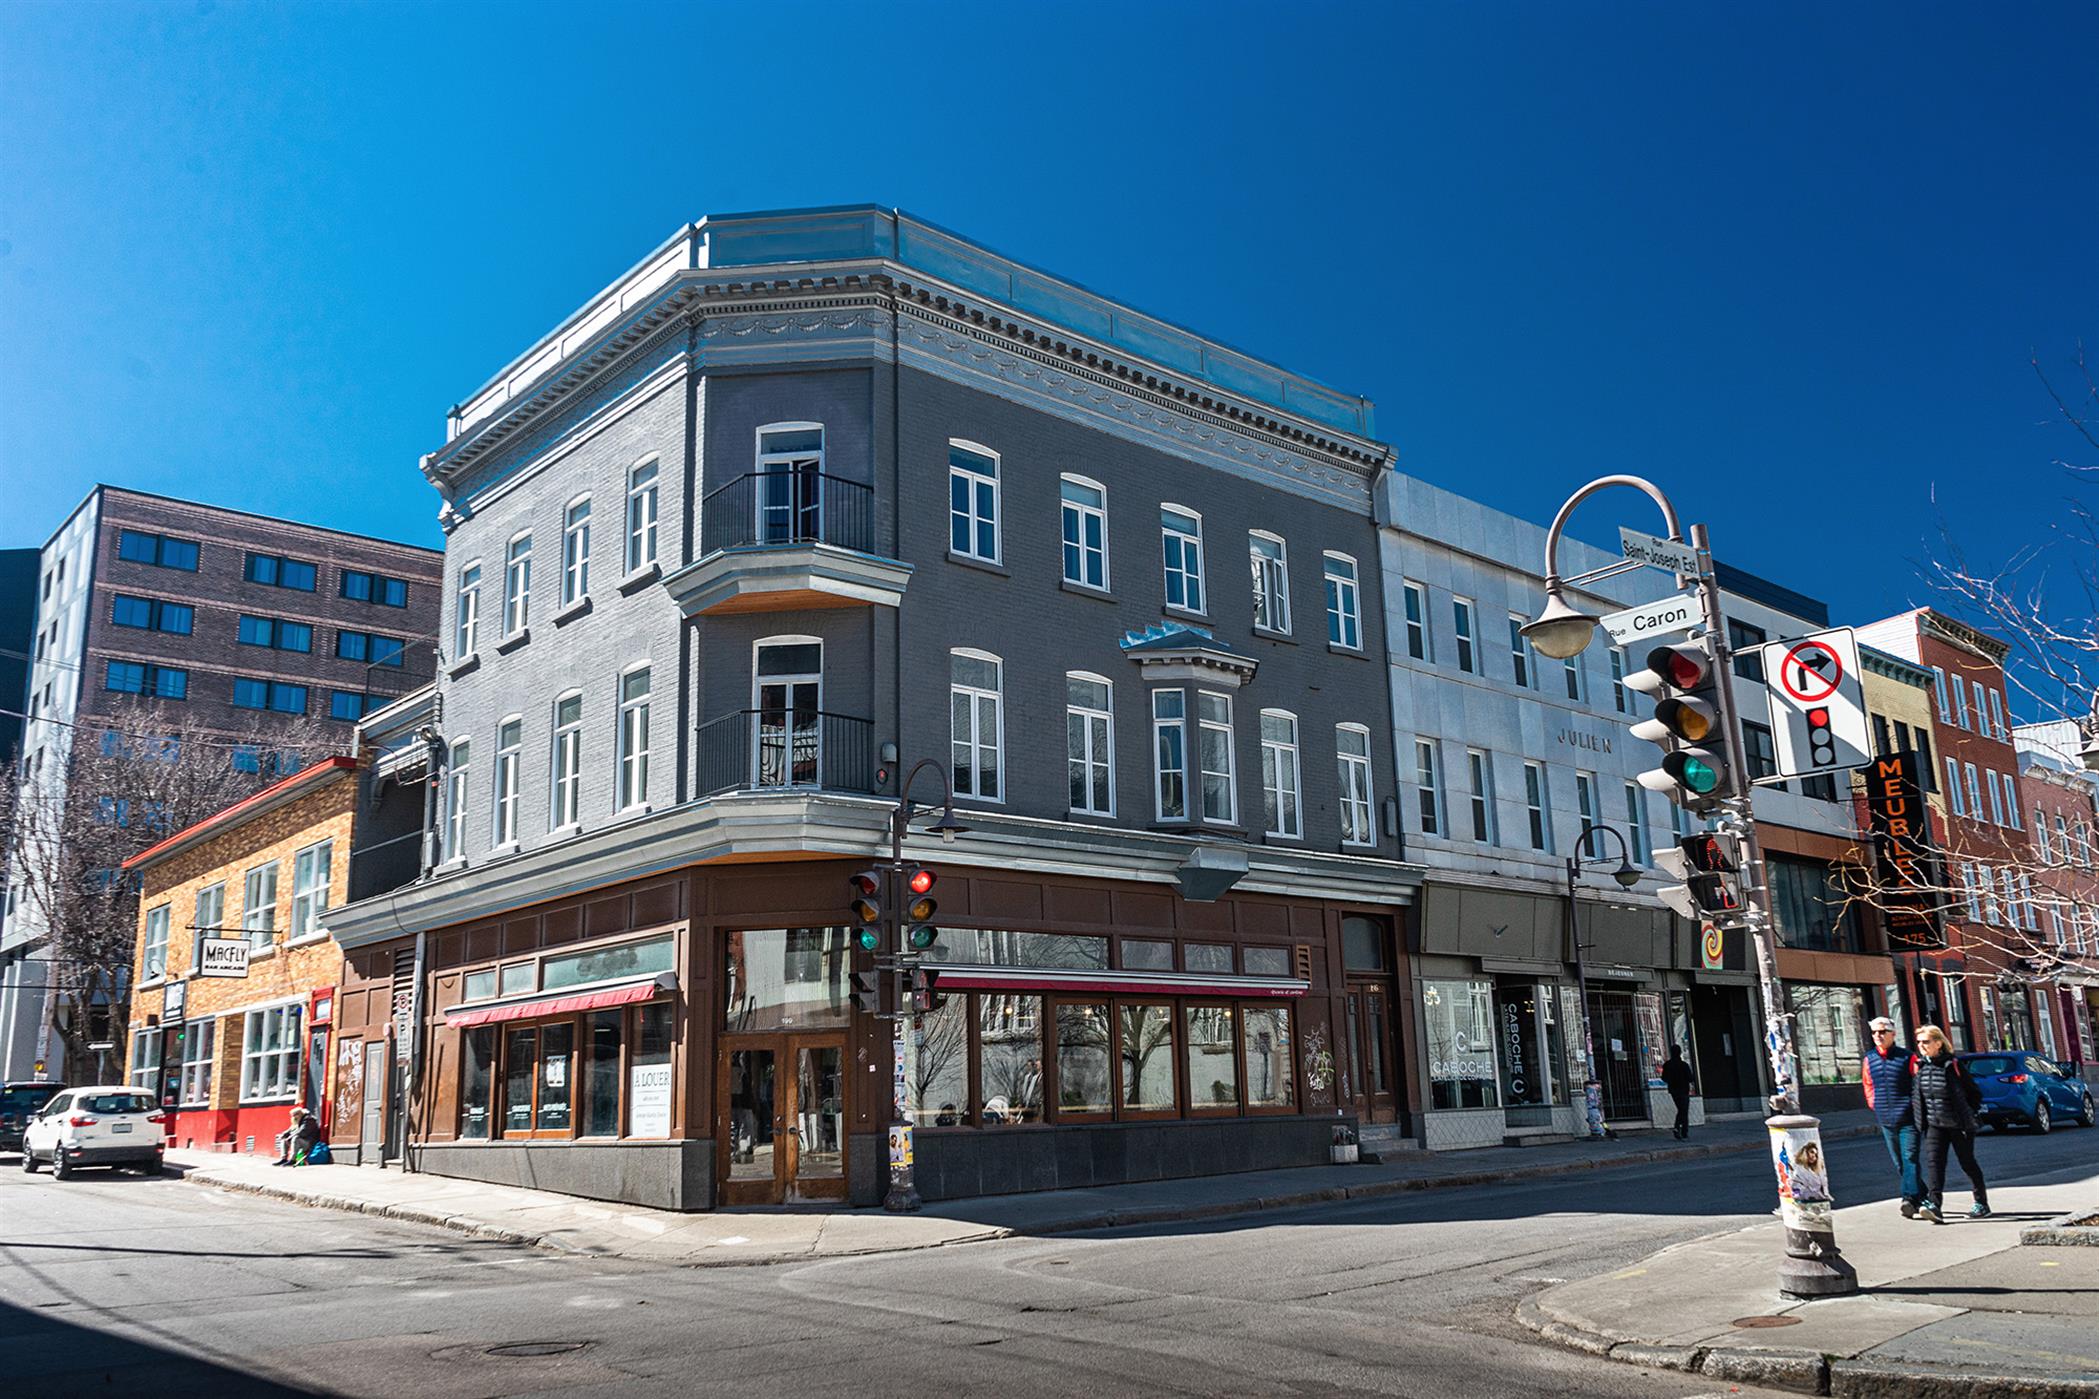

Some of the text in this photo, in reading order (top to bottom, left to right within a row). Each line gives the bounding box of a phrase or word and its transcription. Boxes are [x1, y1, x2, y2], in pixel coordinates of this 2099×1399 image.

[1652, 537, 1663, 548] Rue
[1623, 539, 1698, 574] Saint-Joseph Est
[1633, 608, 1687, 631] Caron
[1608, 628, 1626, 638] Rue
[1557, 727, 1612, 754] JULIEN
[206, 945, 247, 962] MACFLY
[1455, 1031, 1466, 1052] C
[1507, 1003, 1524, 1074] CABOCHE
[1432, 1060, 1493, 1073] CABOCHE
[641, 1072, 670, 1087] LOUER
